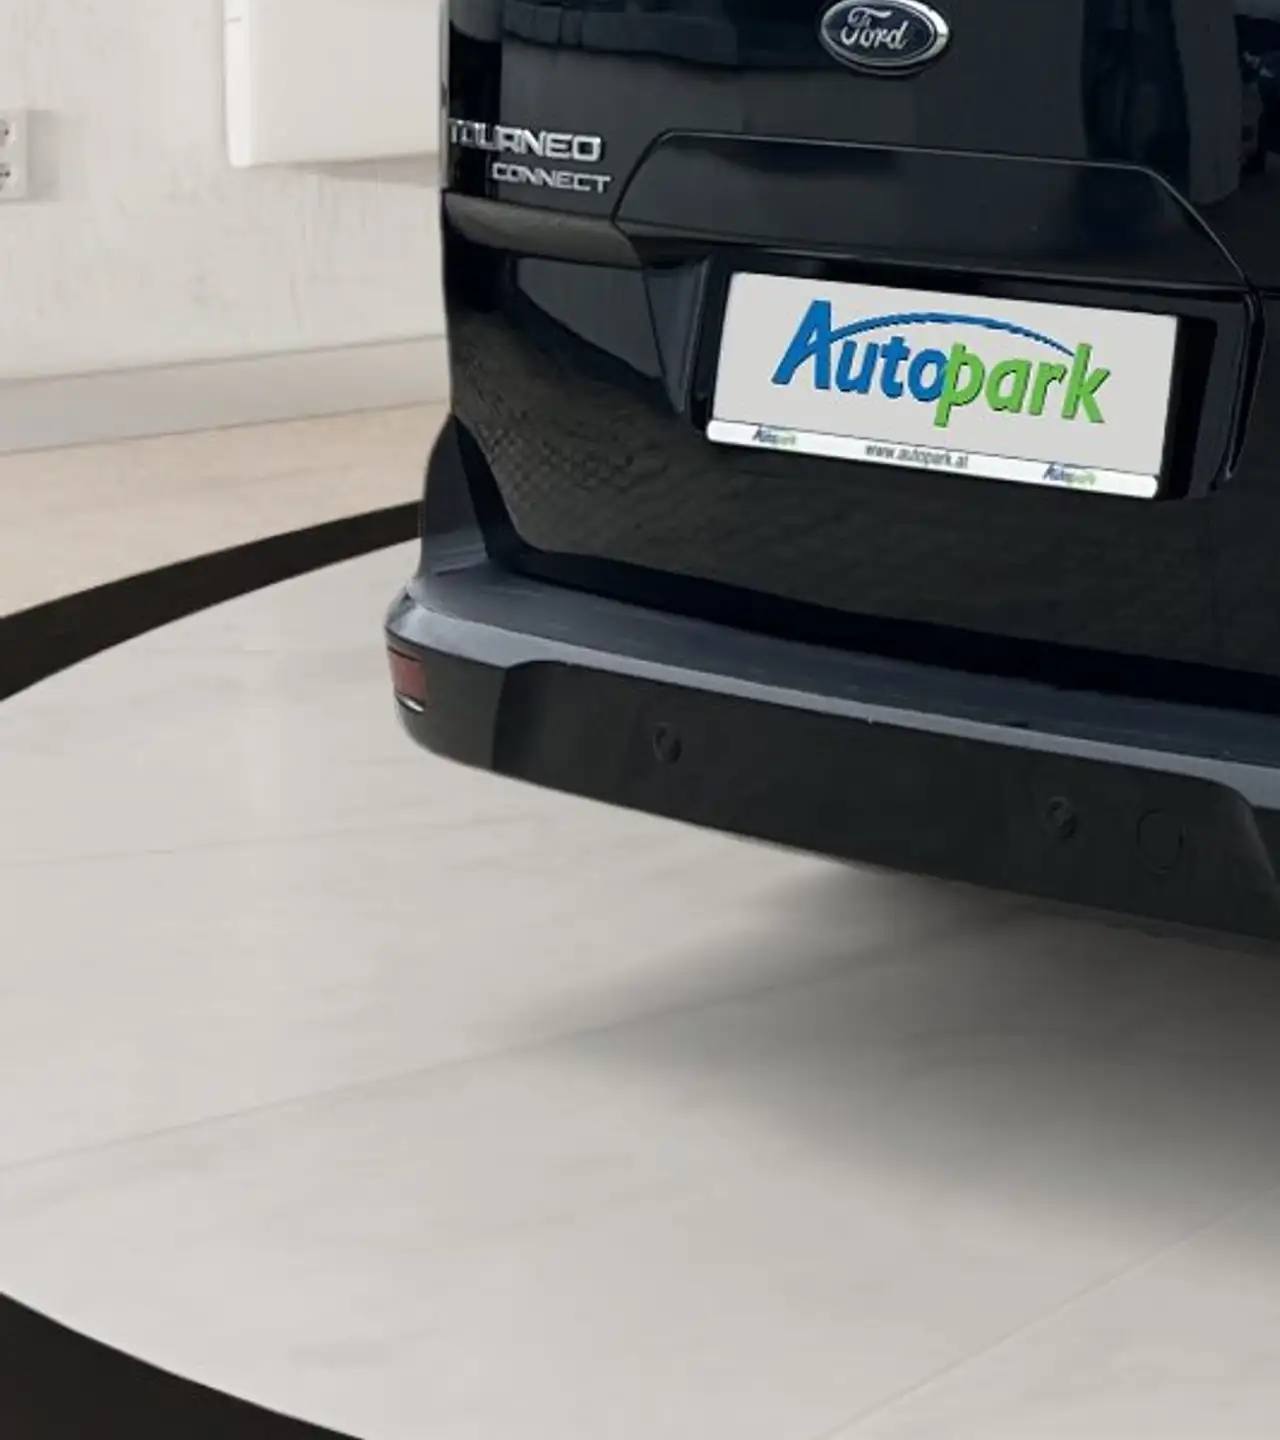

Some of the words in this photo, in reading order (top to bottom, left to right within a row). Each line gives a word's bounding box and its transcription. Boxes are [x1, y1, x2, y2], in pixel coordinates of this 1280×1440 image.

[838, 6, 910, 51] Ford
[491, 162, 612, 194] CONNECT
[771, 299, 1112, 428] Autopark
